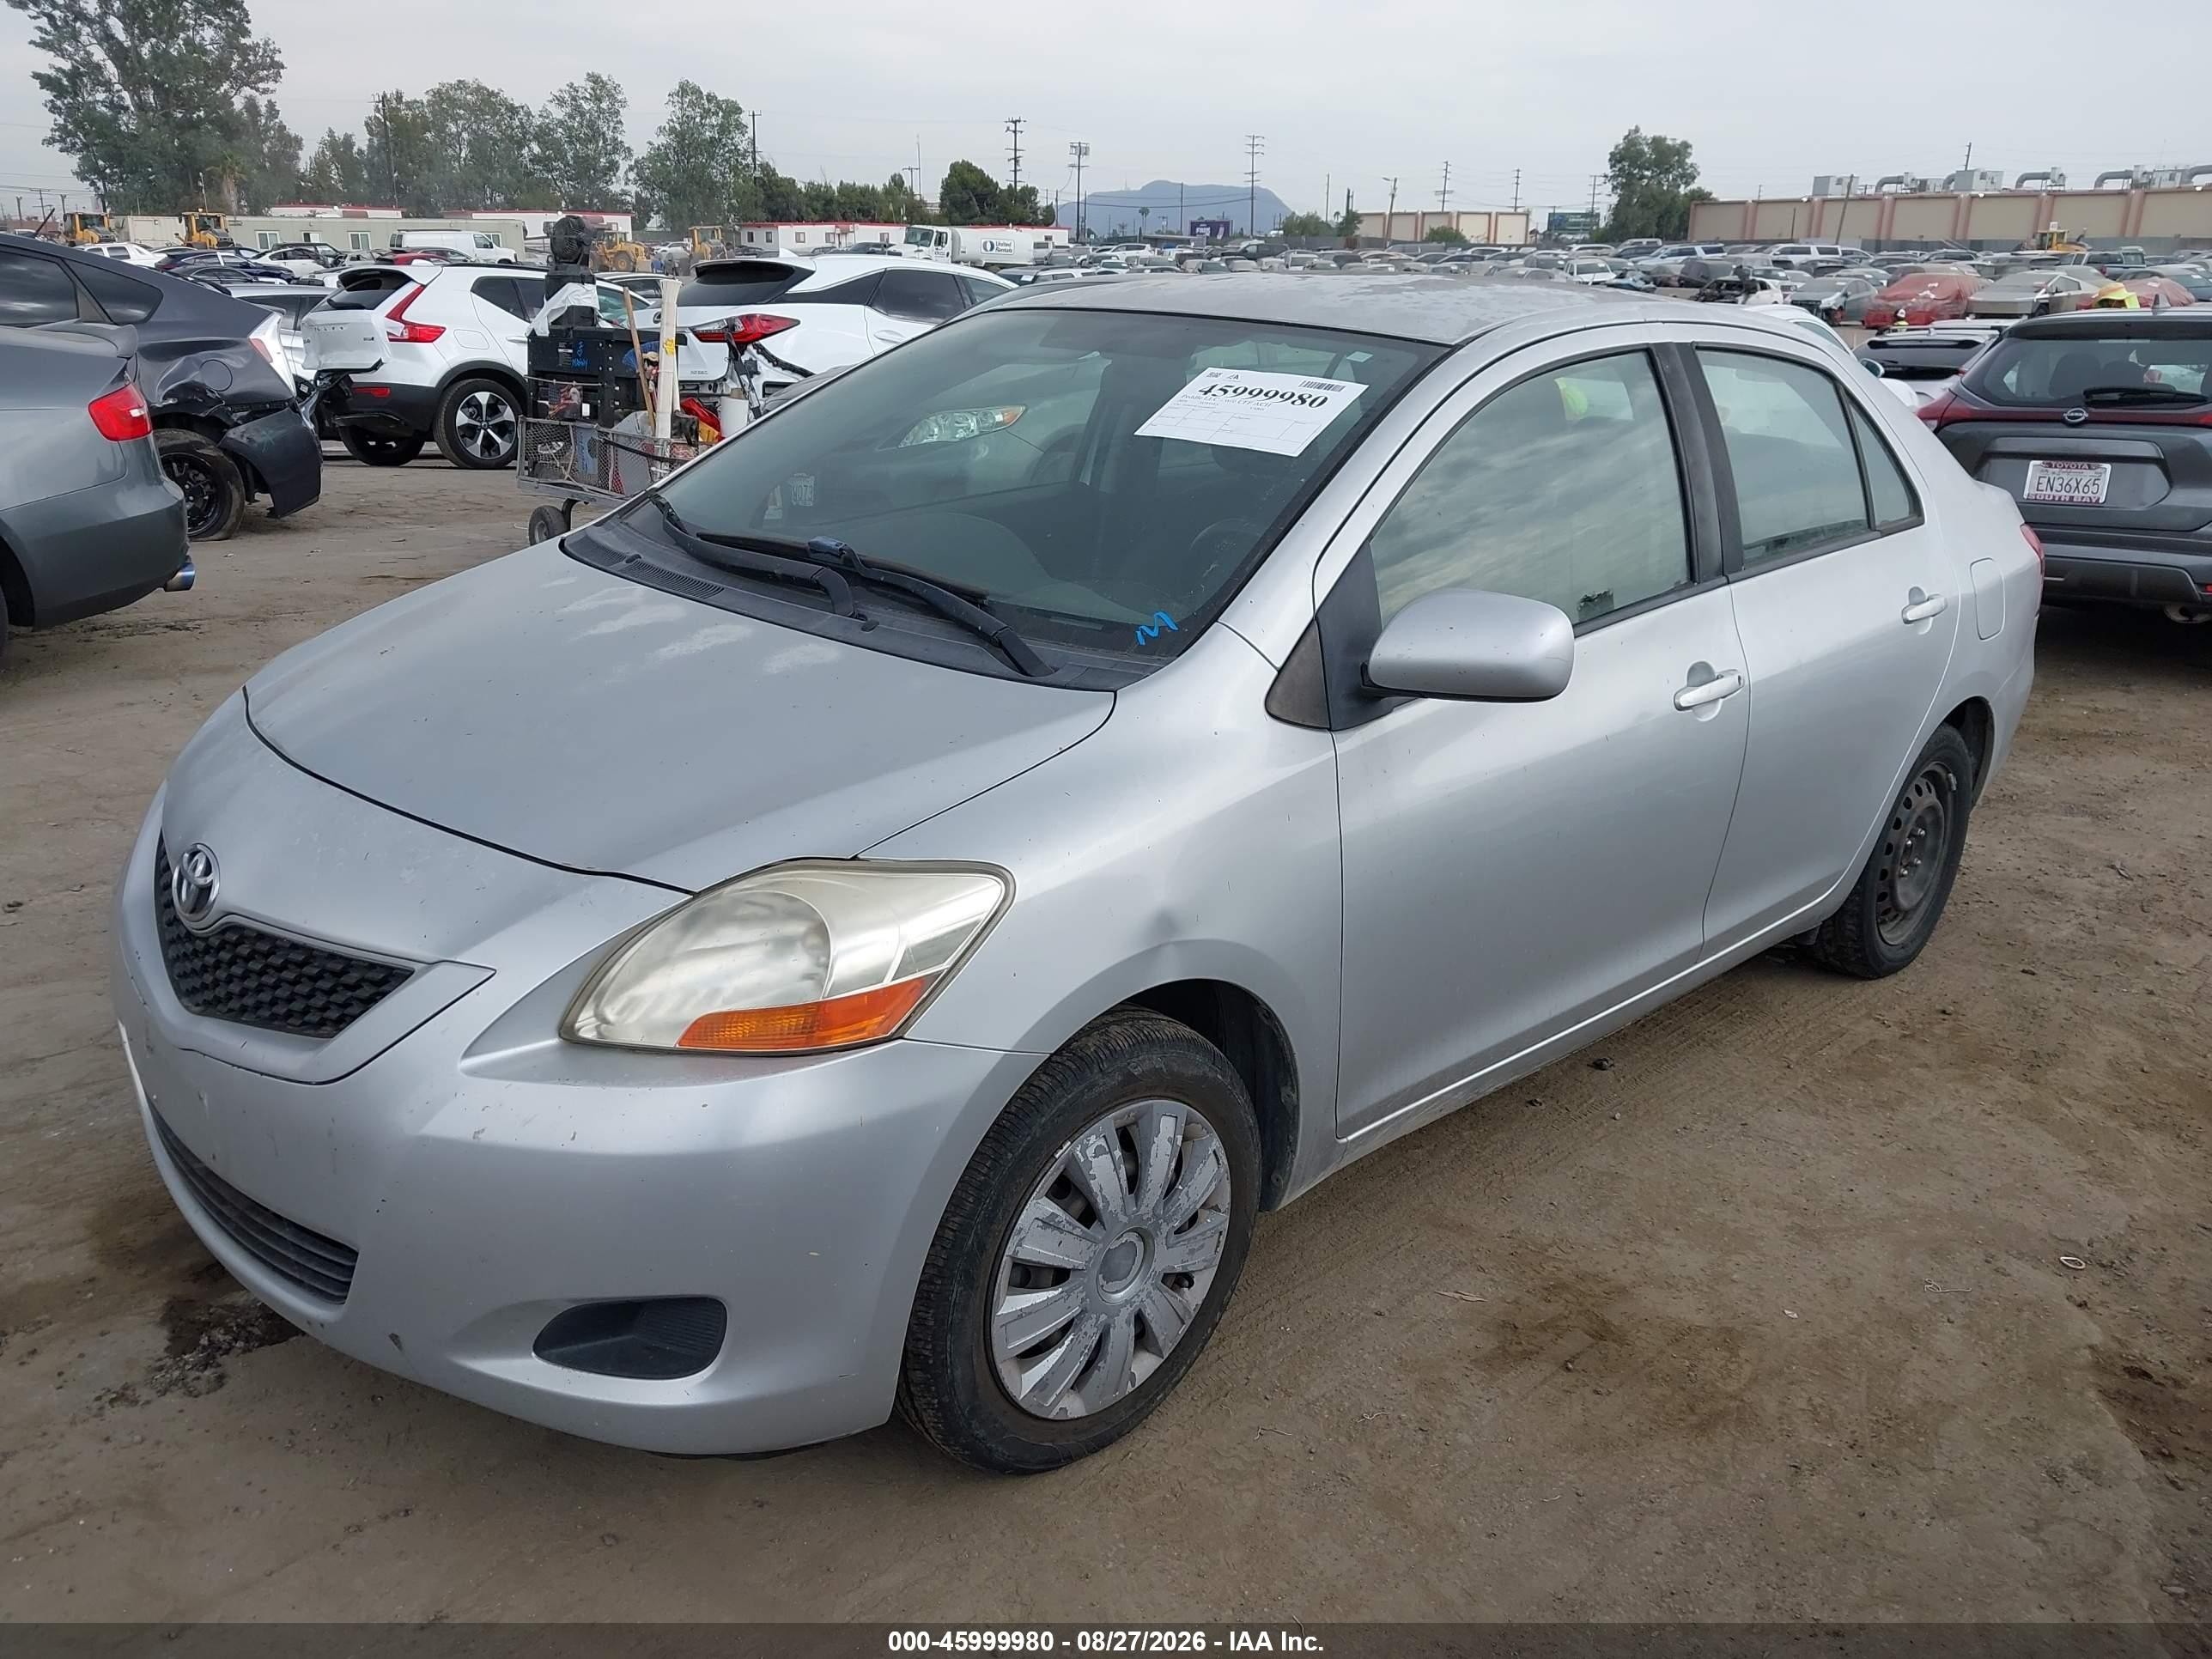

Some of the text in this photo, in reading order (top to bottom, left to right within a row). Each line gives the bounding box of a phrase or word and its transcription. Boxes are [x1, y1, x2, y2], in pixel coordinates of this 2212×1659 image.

[1198, 383, 1328, 408] 45999980
[2051, 461, 2089, 470] TOYOTA
[2036, 476, 2100, 495] EN36X65
